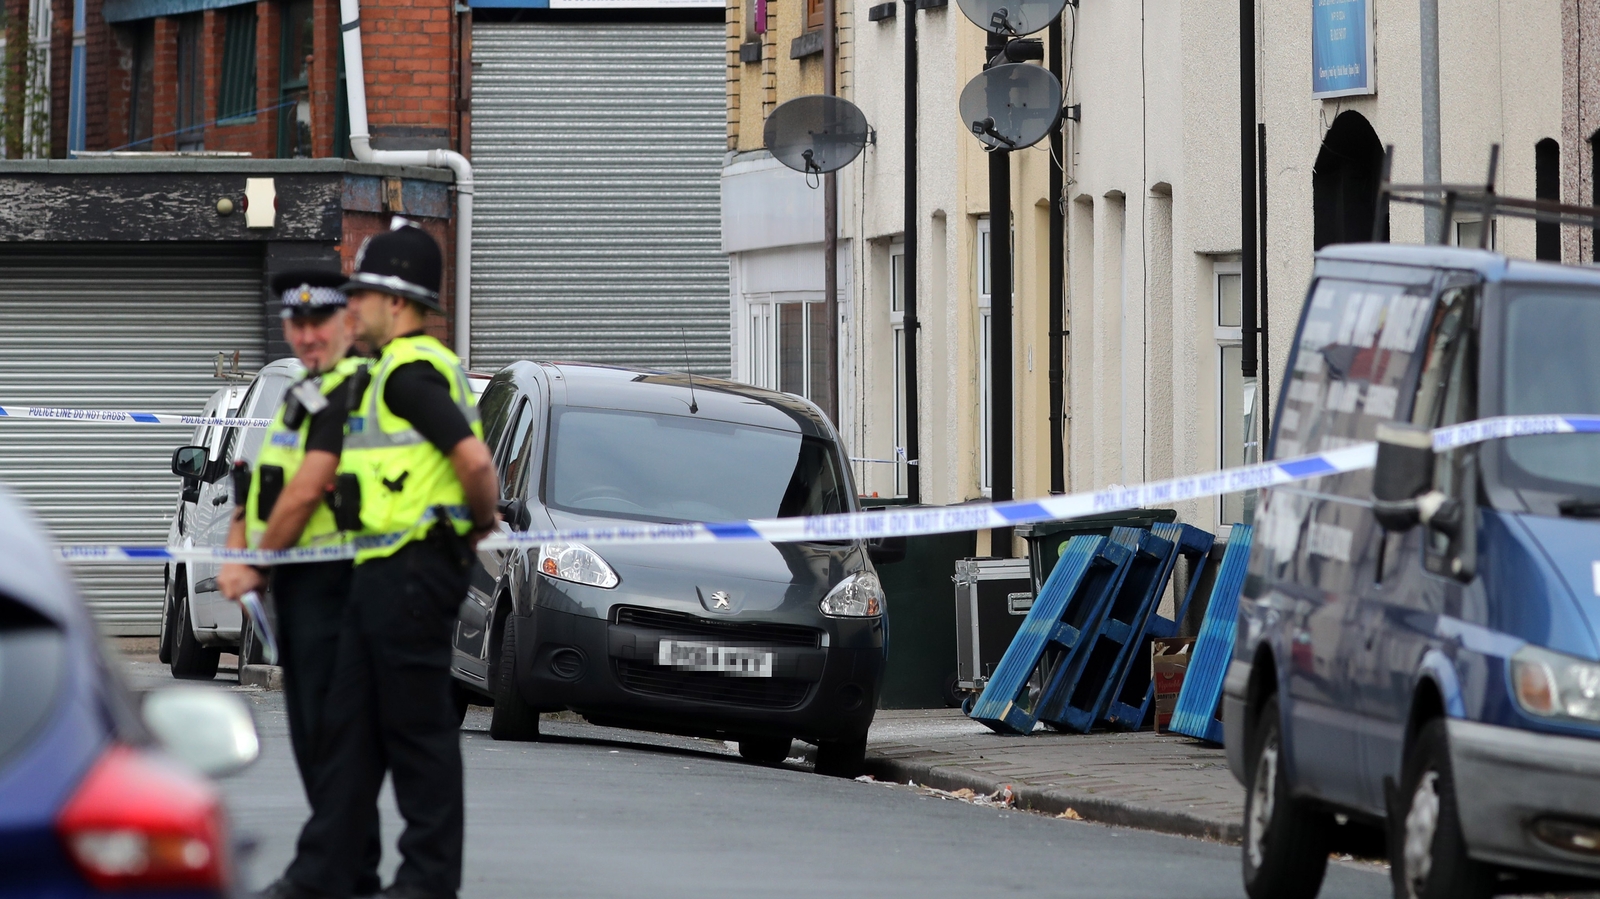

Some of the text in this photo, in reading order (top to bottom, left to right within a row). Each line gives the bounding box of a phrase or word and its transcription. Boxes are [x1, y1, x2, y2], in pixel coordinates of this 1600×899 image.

[29, 407, 126, 421] POLICE LINE DO NOT CROSS
[181, 415, 273, 428] POLICE LINE DO NOT CROS
[1093, 466, 1275, 510] POLICE LINE DO NOT CROSS
[803, 507, 989, 536] POLICE LINE DO NOT CROSS
